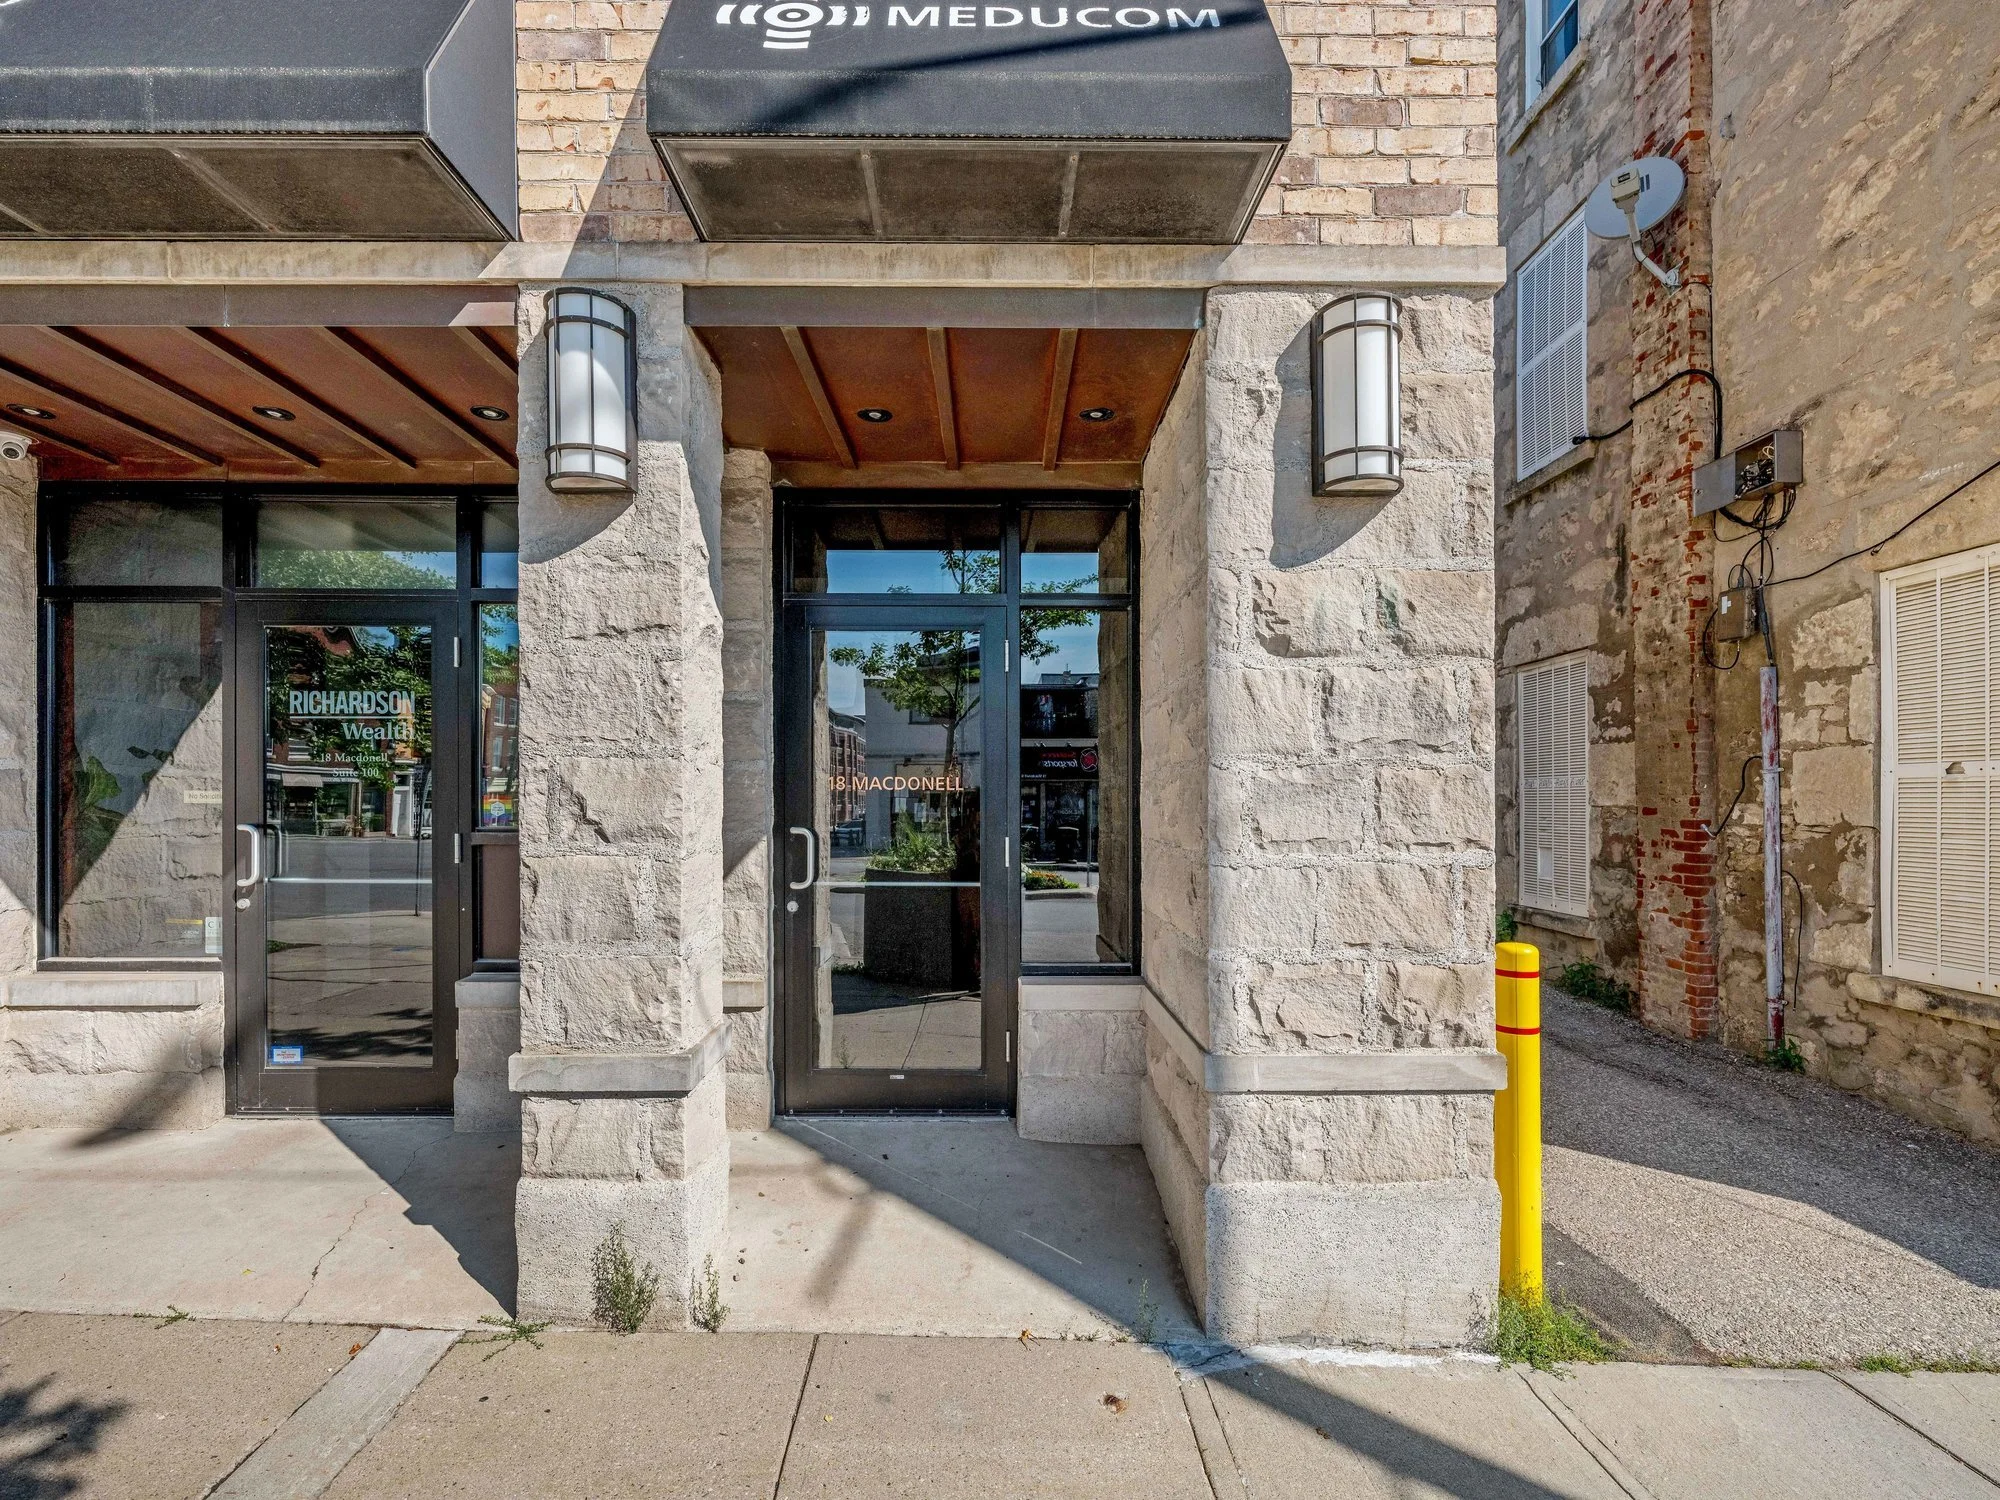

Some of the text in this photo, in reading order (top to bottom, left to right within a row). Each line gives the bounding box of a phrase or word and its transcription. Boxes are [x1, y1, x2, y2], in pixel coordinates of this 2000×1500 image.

[887, 4, 1221, 28] MEDUCOM
[289, 690, 415, 714] RICHARDSON
[341, 722, 415, 740] Wealth
[320, 753, 388, 762] 18 Macdonell
[332, 768, 379, 777] Suite 100
[828, 776, 964, 790] 18 MACDONELL
